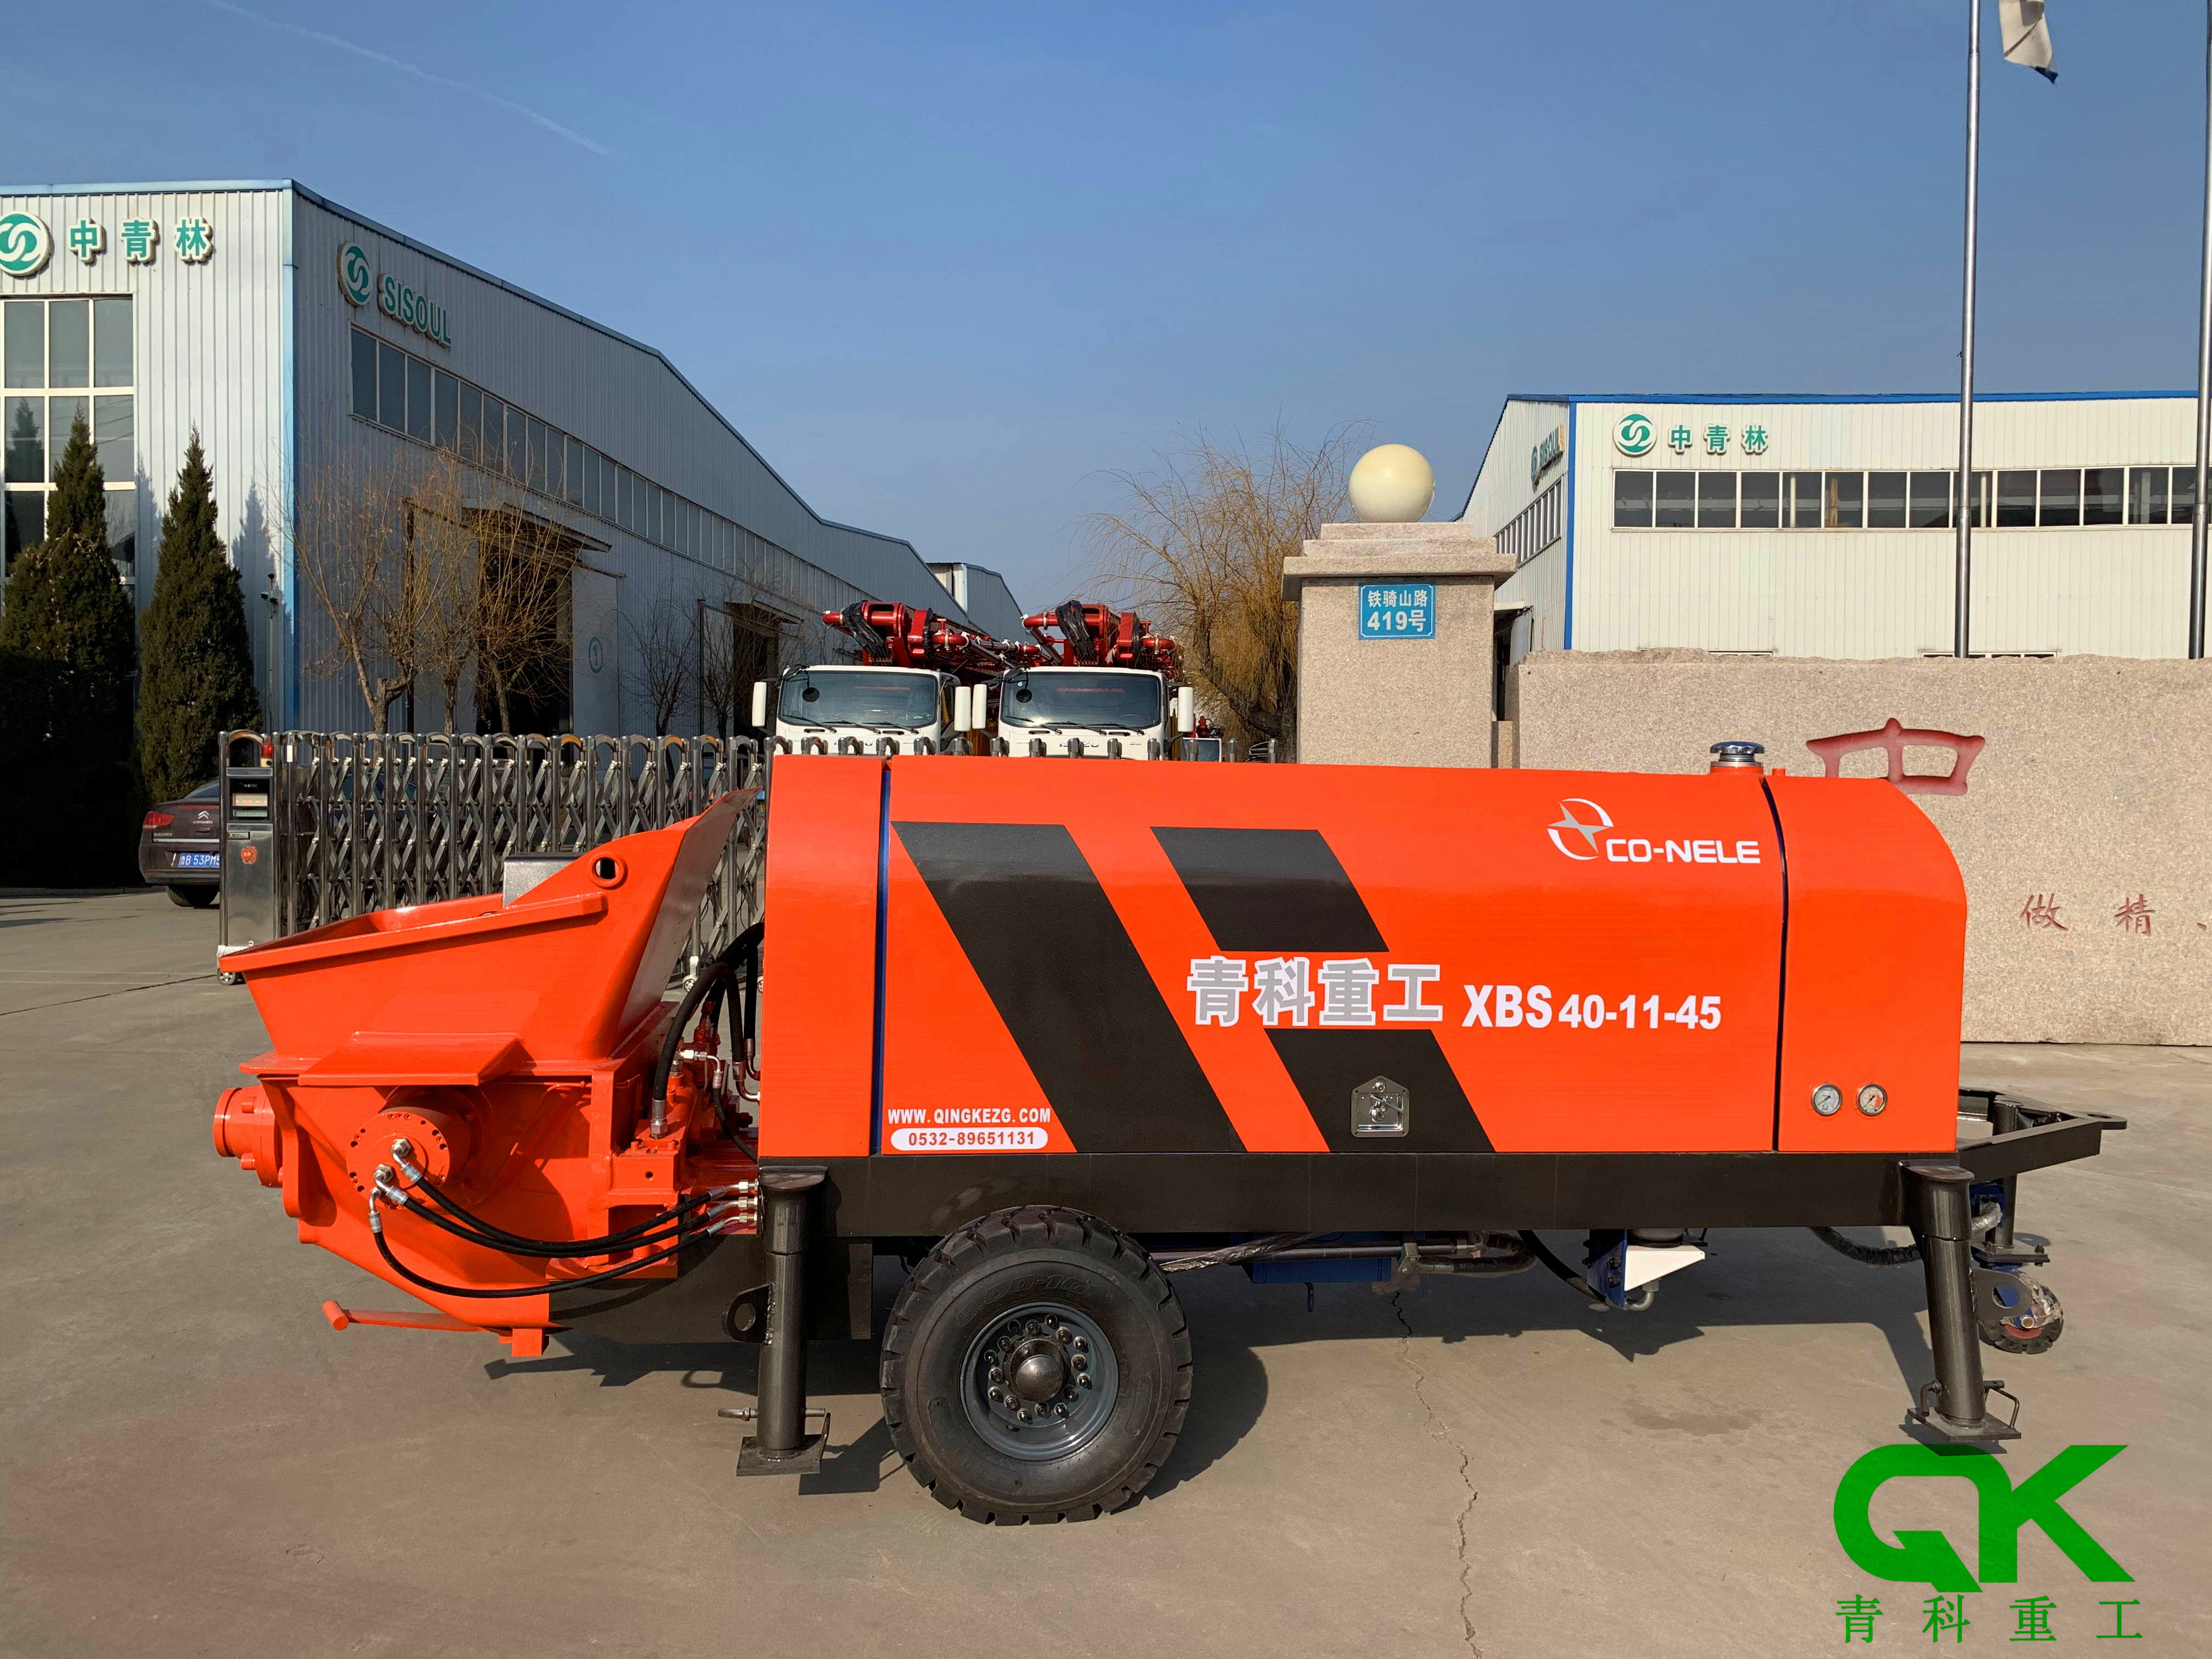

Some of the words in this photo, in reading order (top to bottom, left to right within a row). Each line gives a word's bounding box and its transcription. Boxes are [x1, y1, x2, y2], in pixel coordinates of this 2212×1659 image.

[69, 219, 210, 259] 中青林
[384, 276, 452, 344] SISOUL
[1671, 425, 1766, 451] 中青林
[1368, 589, 1428, 607] 铁骑山路
[1367, 610, 1426, 632] 419号
[1606, 839, 1761, 864] CO-NELE
[1186, 955, 1444, 1027] 青科重工
[1462, 985, 1553, 1028] XBS
[1558, 994, 1722, 1030] 40-11-45
[888, 1107, 1051, 1125] WWW.QINGKEZG.COM
[908, 1131, 1035, 1147] 0532-89651131
